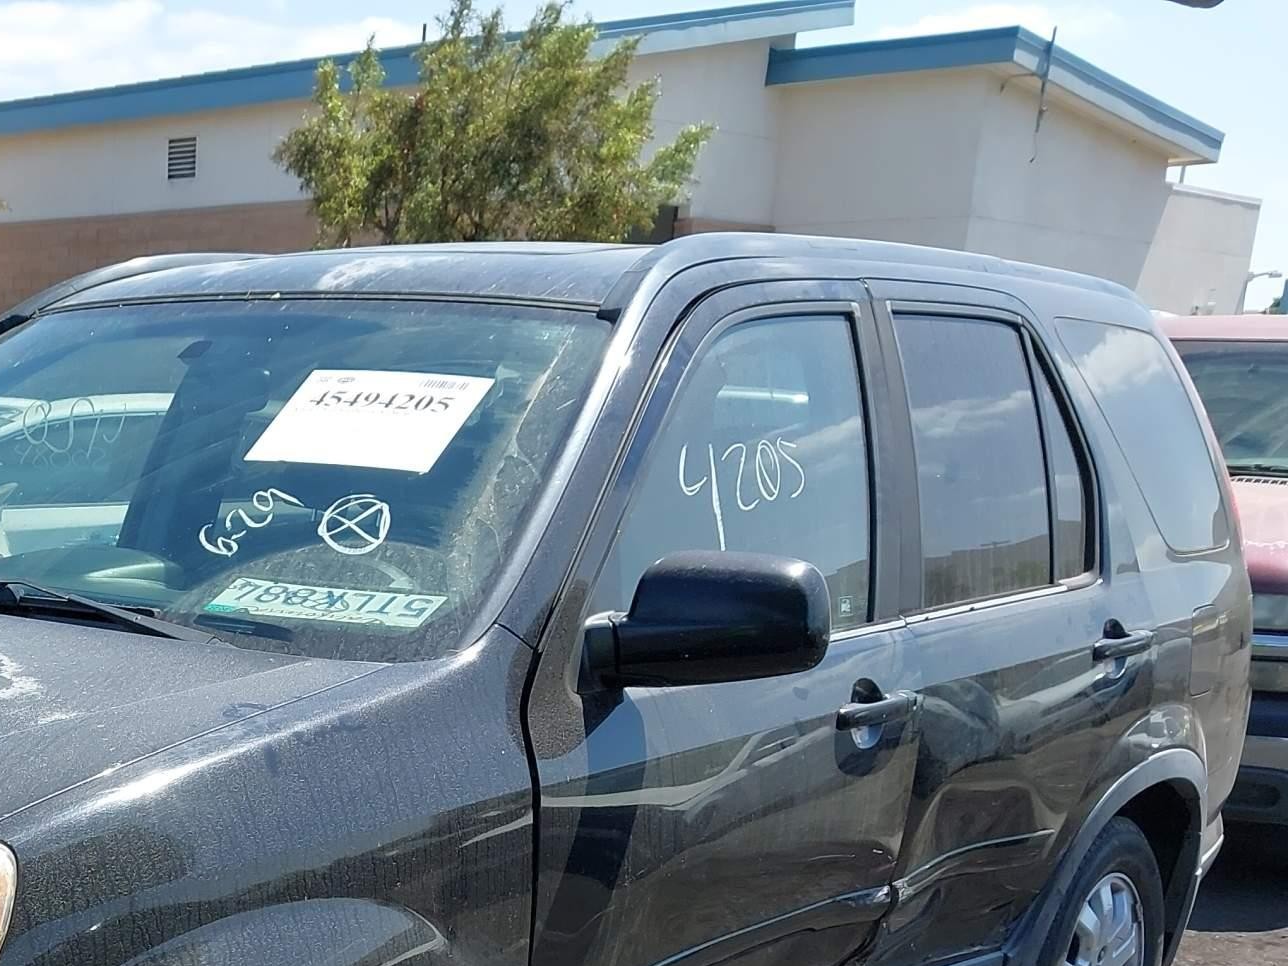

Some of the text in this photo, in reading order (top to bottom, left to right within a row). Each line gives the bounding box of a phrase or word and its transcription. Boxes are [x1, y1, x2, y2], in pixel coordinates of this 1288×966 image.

[308, 389, 457, 413] 45494205
[198, 487, 305, 558] 6-29
[678, 431, 806, 552] 4205
